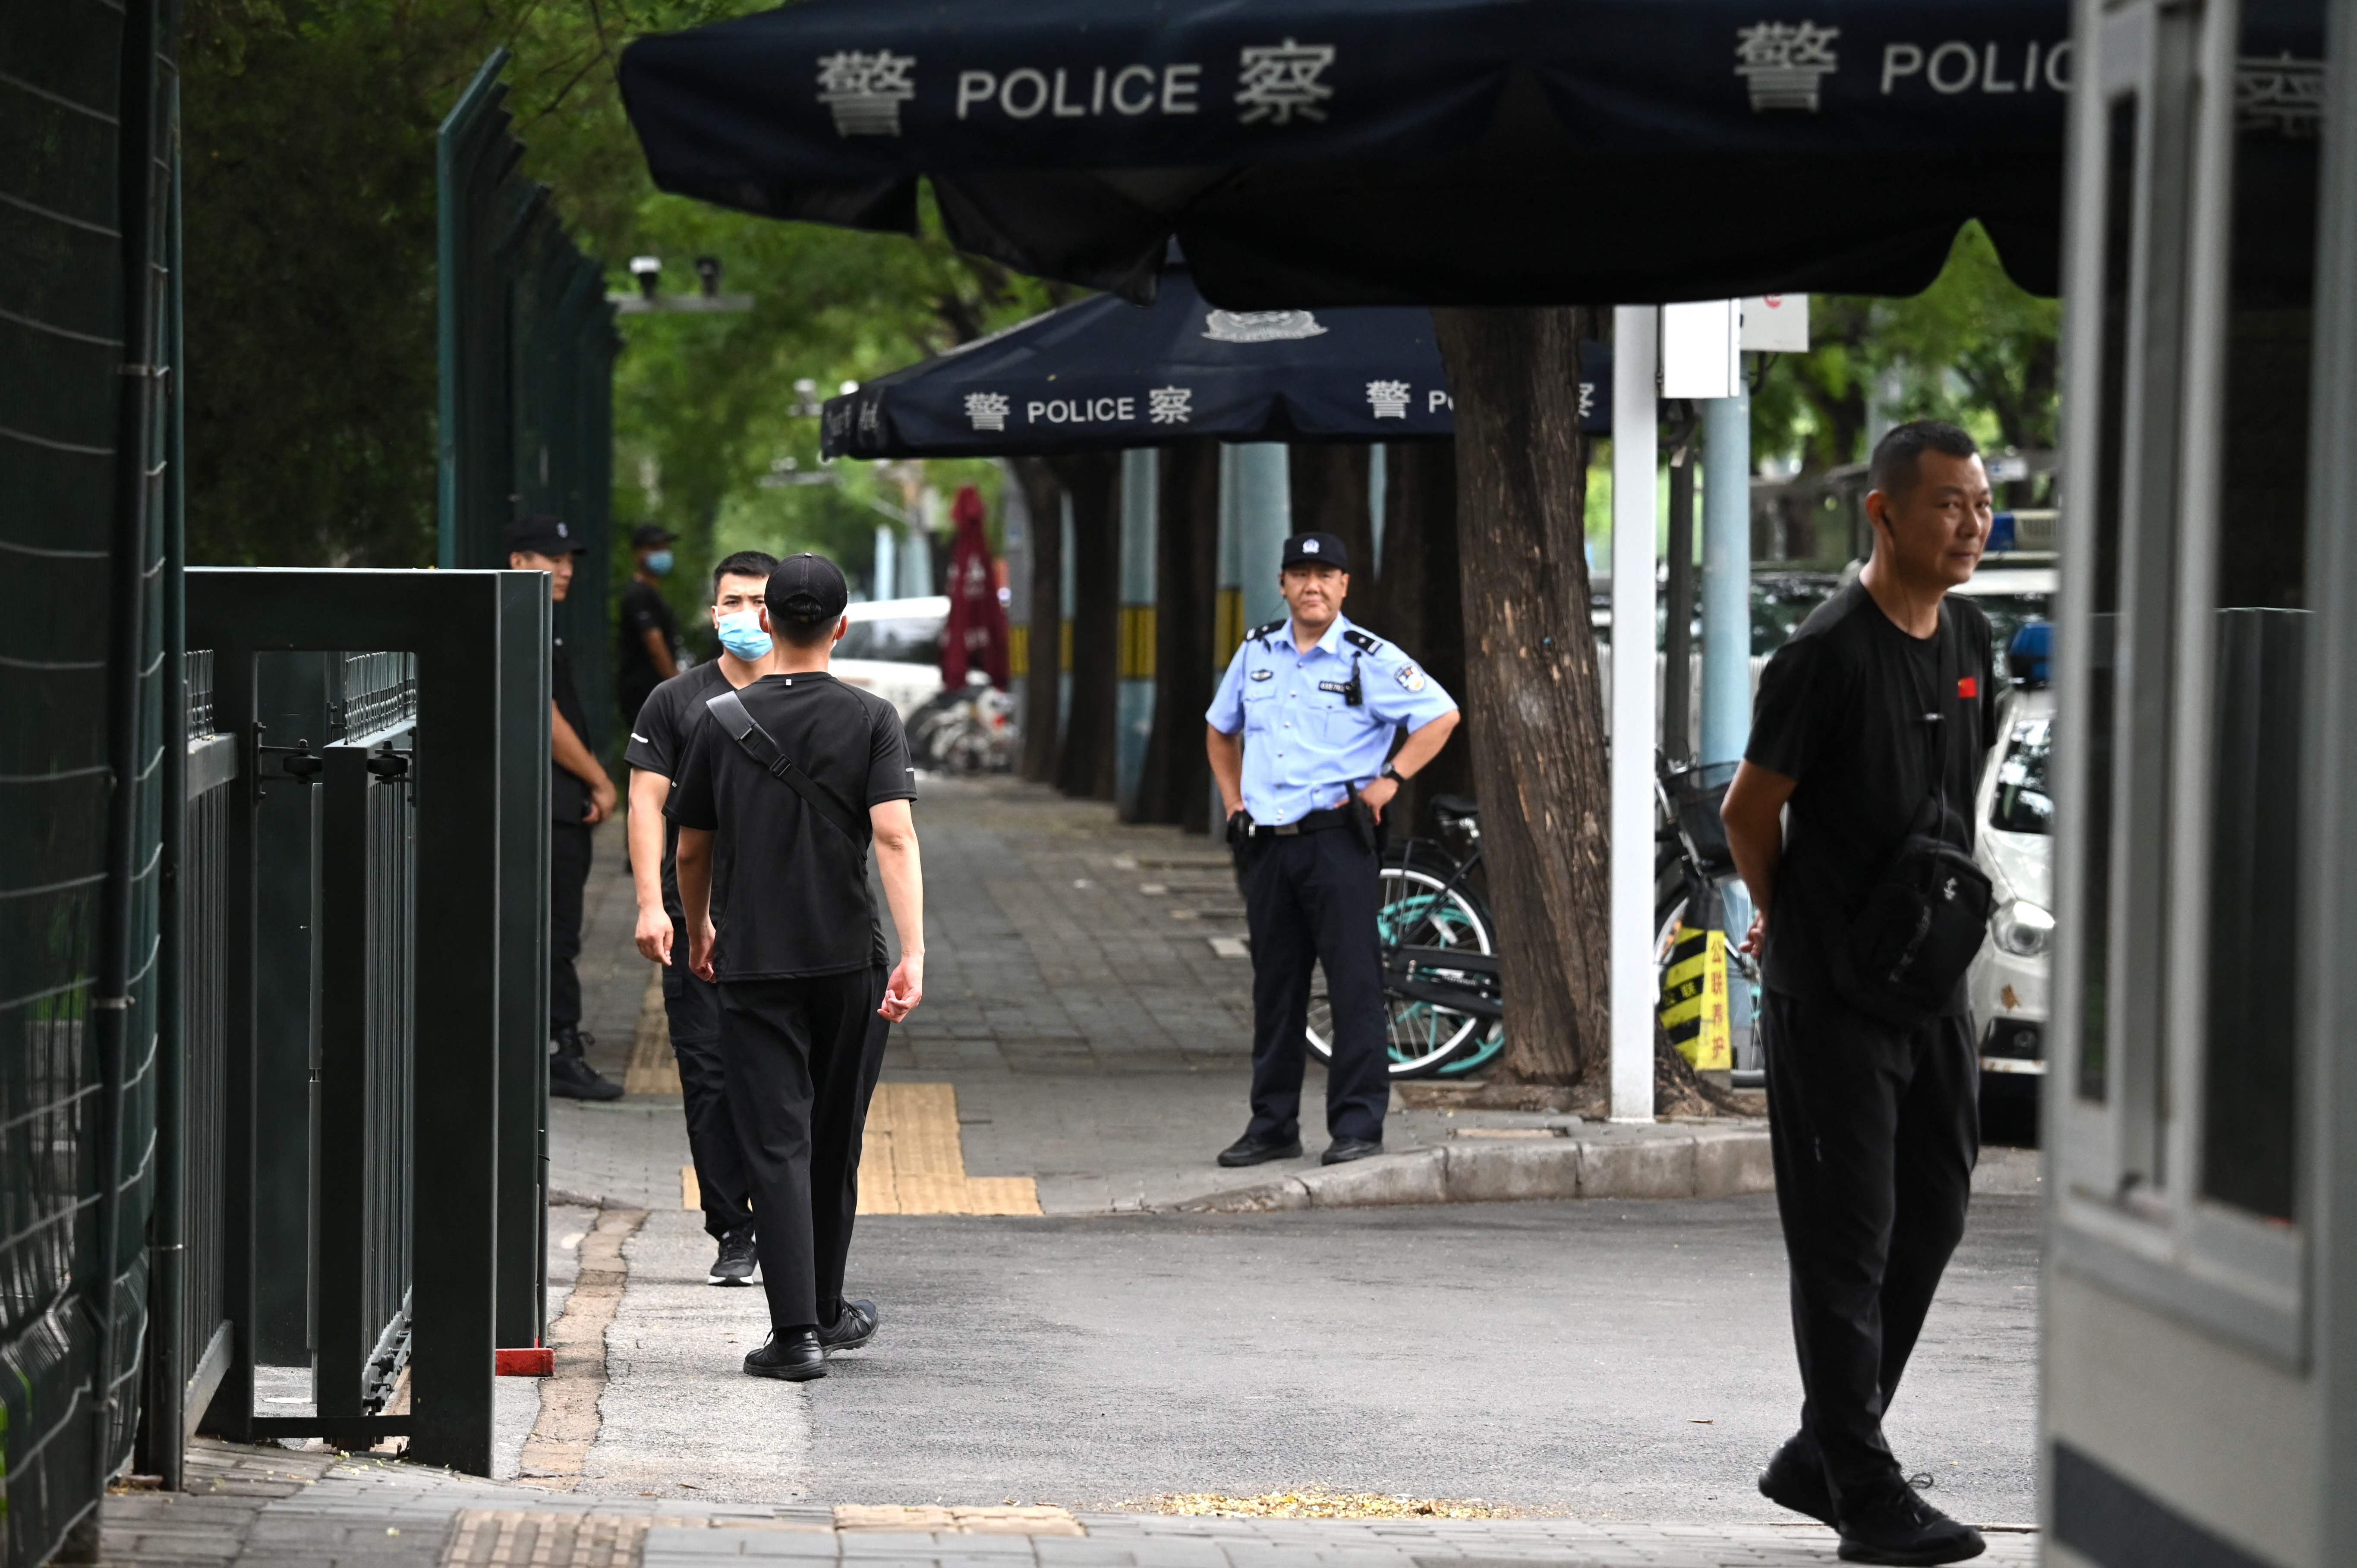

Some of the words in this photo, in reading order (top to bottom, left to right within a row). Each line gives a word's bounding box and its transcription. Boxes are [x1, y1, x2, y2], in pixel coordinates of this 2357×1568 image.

[816, 49, 916, 137] 警
[957, 64, 1202, 120] POLICE
[1234, 36, 1335, 125] 察
[1734, 21, 1840, 113] 警
[1880, 40, 2074, 95] POLIC
[964, 392, 1010, 431] 警
[1027, 397, 1135, 423] POLICE
[1148, 385, 1192, 425] 察
[1366, 379, 1412, 419] 警
